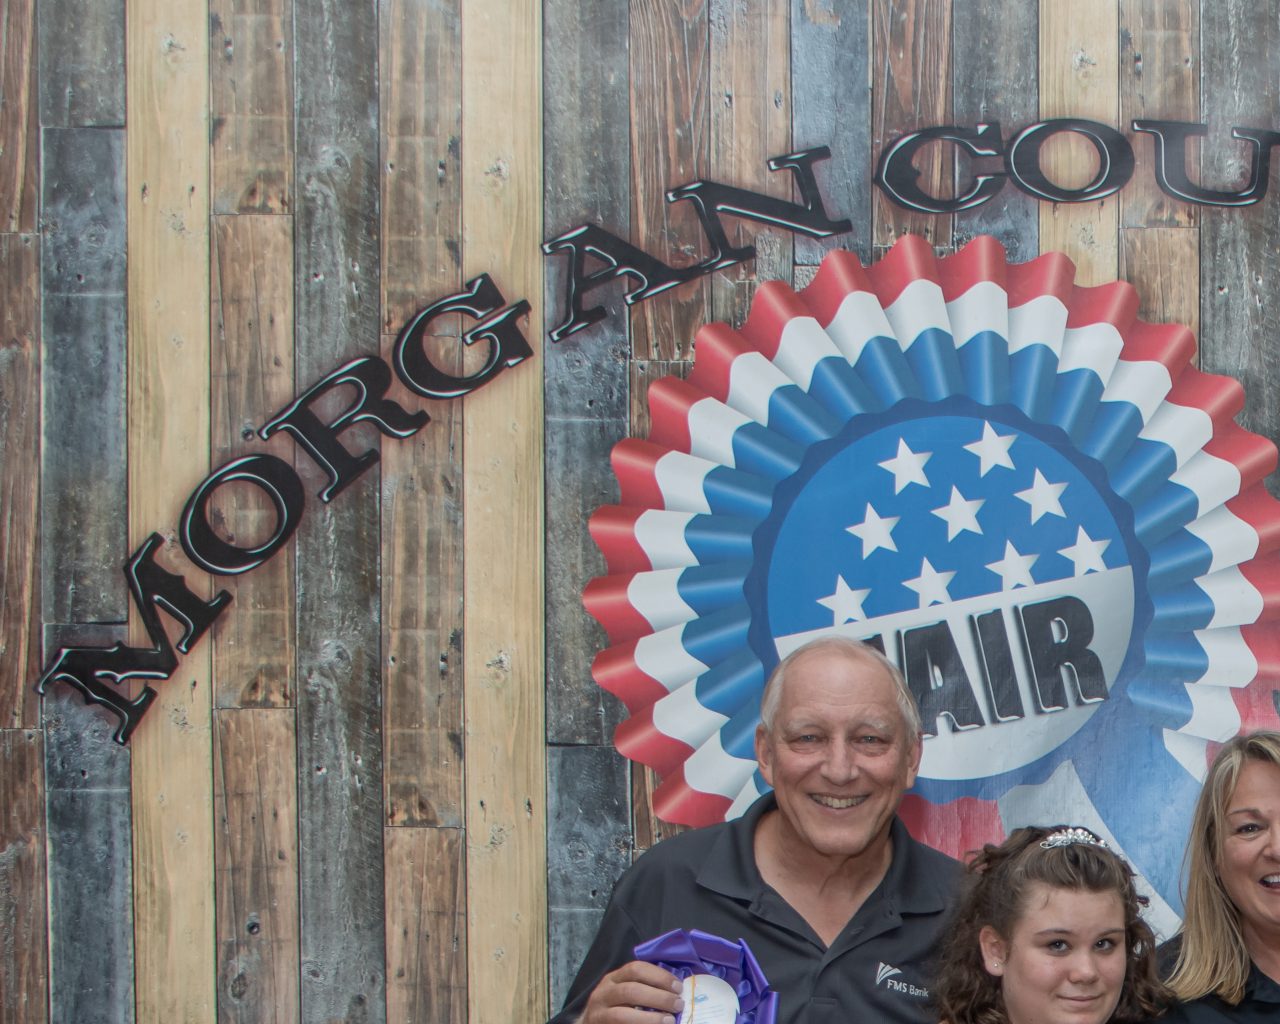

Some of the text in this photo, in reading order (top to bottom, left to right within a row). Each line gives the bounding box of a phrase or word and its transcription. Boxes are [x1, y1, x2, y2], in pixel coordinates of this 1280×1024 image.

[36, 145, 853, 747] MORGAN
[862, 595, 1109, 739] AIR
[887, 979, 929, 997] FMS Bank
